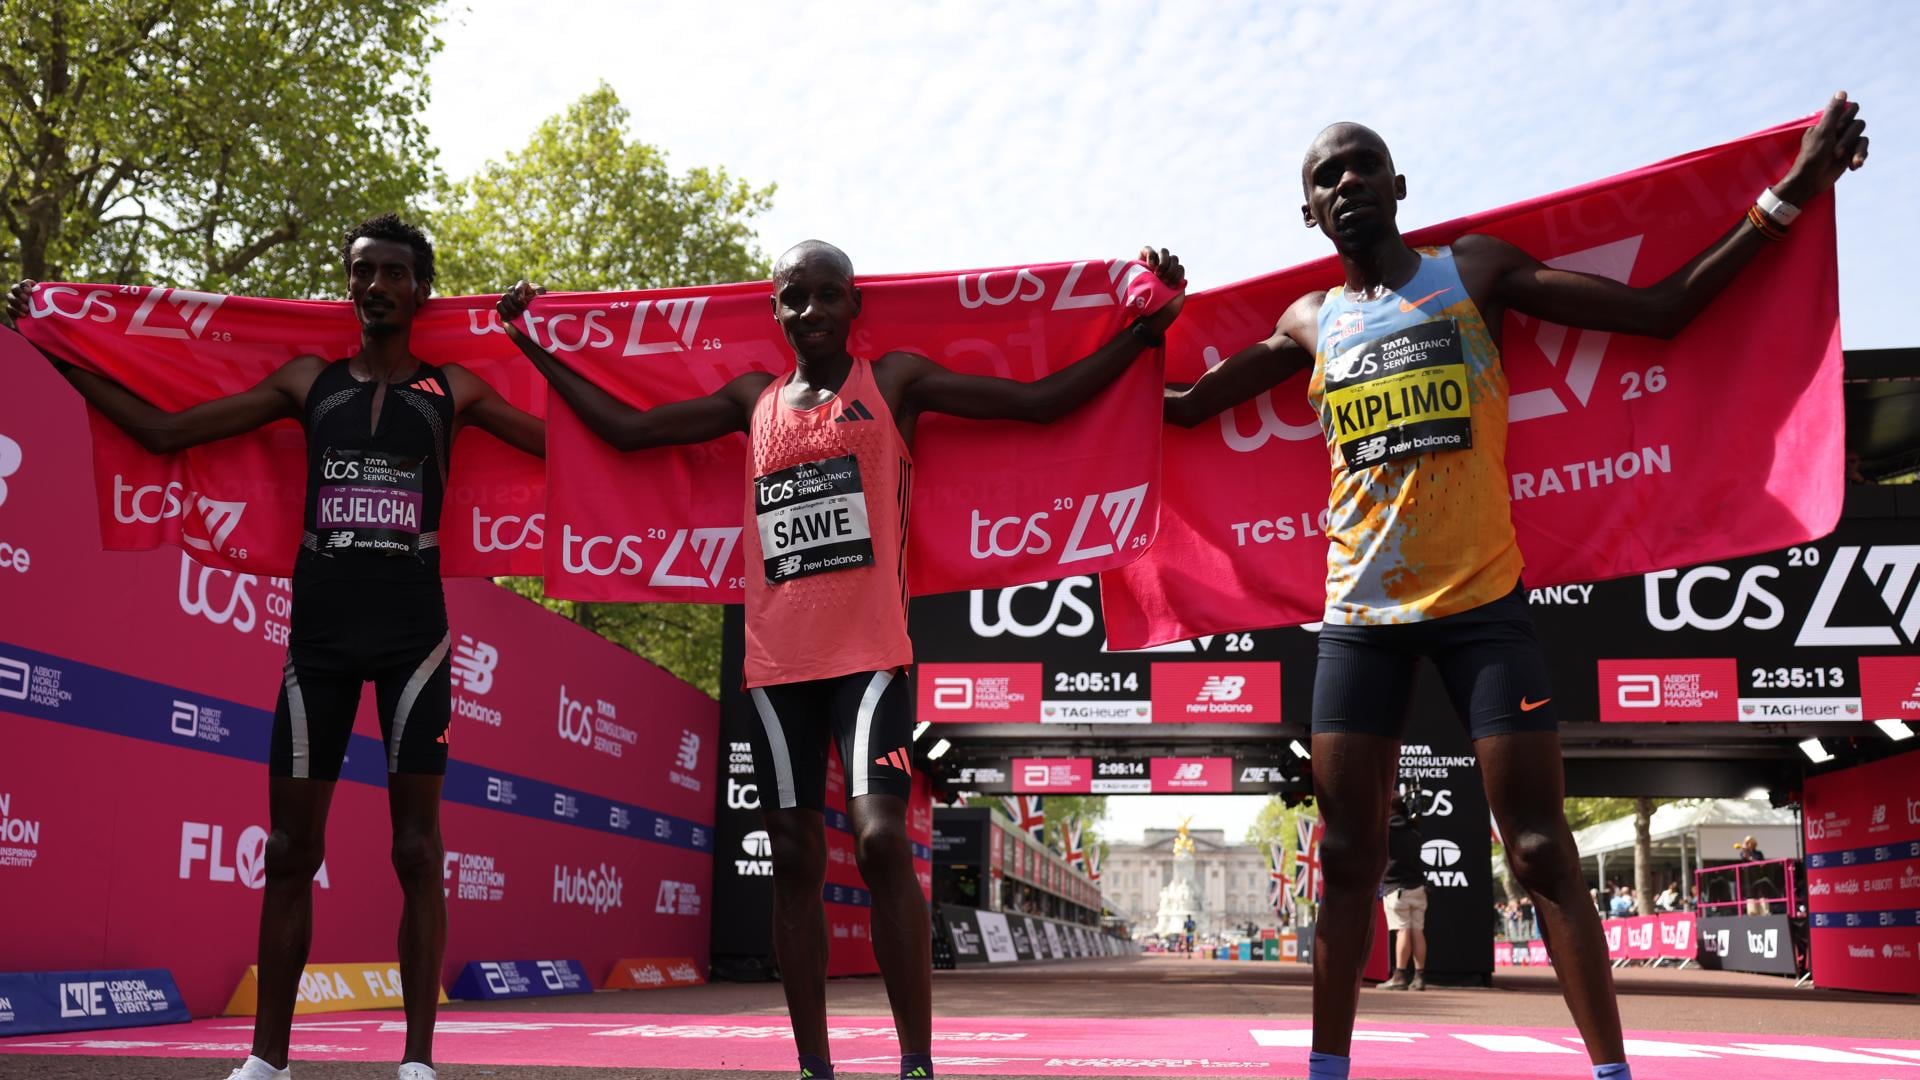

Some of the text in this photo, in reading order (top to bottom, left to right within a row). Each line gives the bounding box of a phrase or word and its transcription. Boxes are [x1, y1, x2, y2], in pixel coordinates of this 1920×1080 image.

[958, 268, 1045, 309] tcs
[28, 284, 117, 322] tcs
[212, 331, 232, 342] 26
[524, 309, 614, 353] tcs
[702, 338, 722, 350] 26
[1381, 336, 1410, 352] TATA
[1382, 338, 1451, 361] CONSULTANCY
[1383, 352, 1428, 371] SERVICES
[1620, 365, 1667, 401] 26
[1336, 379, 1462, 436] KIPLIMO
[1389, 434, 1461, 455] new balance
[324, 458, 359, 479] tcs
[364, 458, 387, 466] TATA
[363, 466, 416, 479] CONSULTANCY
[363, 473, 397, 483] SERVICES
[796, 468, 819, 479] TATA
[797, 471, 852, 489] CONSULTANCY
[1509, 445, 1672, 501] RATHON
[760, 480, 794, 505] tcs
[797, 482, 833, 496] SERVICES
[113, 474, 183, 523] tcs
[229, 547, 247, 560] 26
[322, 497, 416, 528] KEJELCHA
[774, 508, 852, 549] SAWE
[970, 508, 1052, 560] tcs
[1053, 497, 1074, 511] 20
[1132, 533, 1147, 549] 26
[1231, 516, 1296, 547] TCS
[354, 540, 410, 551] new balance
[563, 524, 643, 576] tcs
[648, 528, 666, 540] 20
[729, 577, 745, 588] 26
[803, 554, 863, 572] new balance
[179, 550, 258, 633] tcs
[1644, 565, 1785, 631] tcs
[1788, 548, 1819, 567] 20
[969, 575, 1094, 638] tcs
[1225, 633, 1254, 652] 26
[1055, 672, 1138, 692] 2:05:14
[1664, 674, 1700, 682] ABBOTT
[1664, 682, 1699, 691] WORLD
[1752, 667, 1845, 688] 2:35:13
[1664, 690, 1718, 699] MARATHON
[1664, 699, 1703, 708] MAJORS
[458, 696, 501, 727] balance
[558, 684, 593, 747] tcs
[1186, 703, 1253, 713] new balance
[730, 742, 751, 752] TAT
[1400, 745, 1432, 755] TATA
[1099, 763, 1143, 775] 2:05:14
[1399, 757, 1476, 767] CONSULTANCY
[727, 778, 761, 810] tc
[458, 852, 495, 871] LONDON
[735, 860, 774, 876] TAT
[458, 868, 505, 888] MARATHON
[1424, 871, 1469, 887] ATA
[458, 885, 488, 901] EVENTS
[553, 863, 623, 914] HubSpot
[105, 980, 147, 992] LONDON
[297, 968, 403, 1003] ORA FLO
[110, 989, 166, 1003] MARATHON
[114, 1001, 151, 1014] EVENTS
